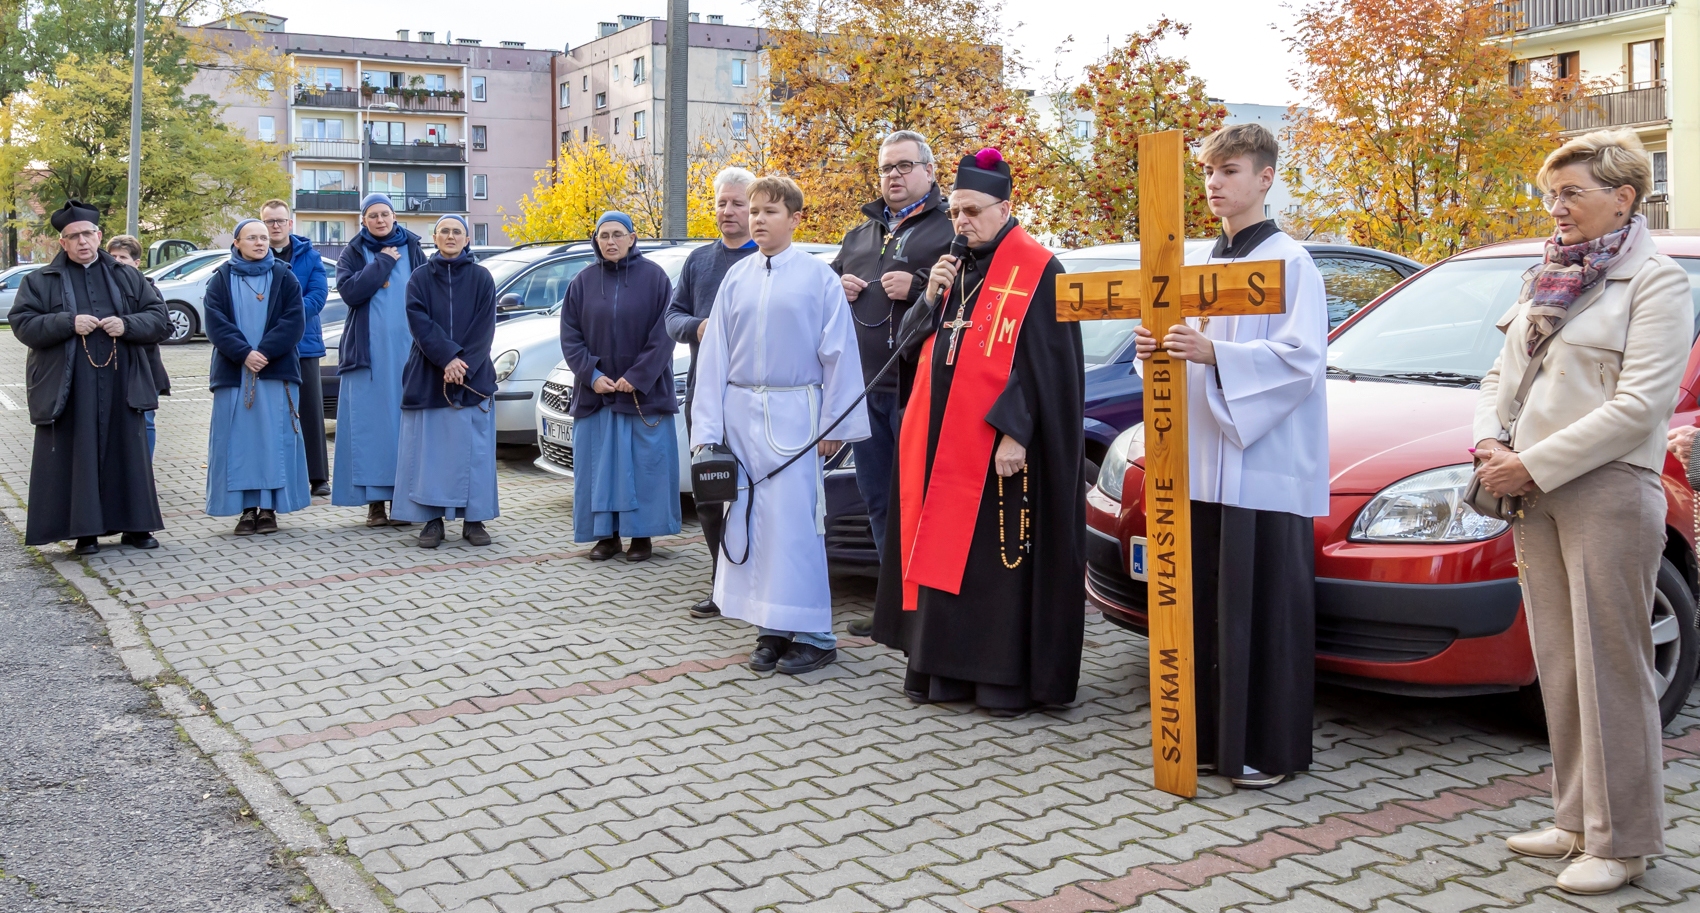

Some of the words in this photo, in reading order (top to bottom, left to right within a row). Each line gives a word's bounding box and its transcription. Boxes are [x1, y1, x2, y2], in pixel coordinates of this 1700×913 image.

[1069, 271, 1266, 312] JEZUS
[998, 317, 1017, 344] M
[1152, 478, 1177, 606] WŁAŚNIE
[1134, 561, 1142, 571] PL
[1159, 648, 1181, 764] SZUKAM
